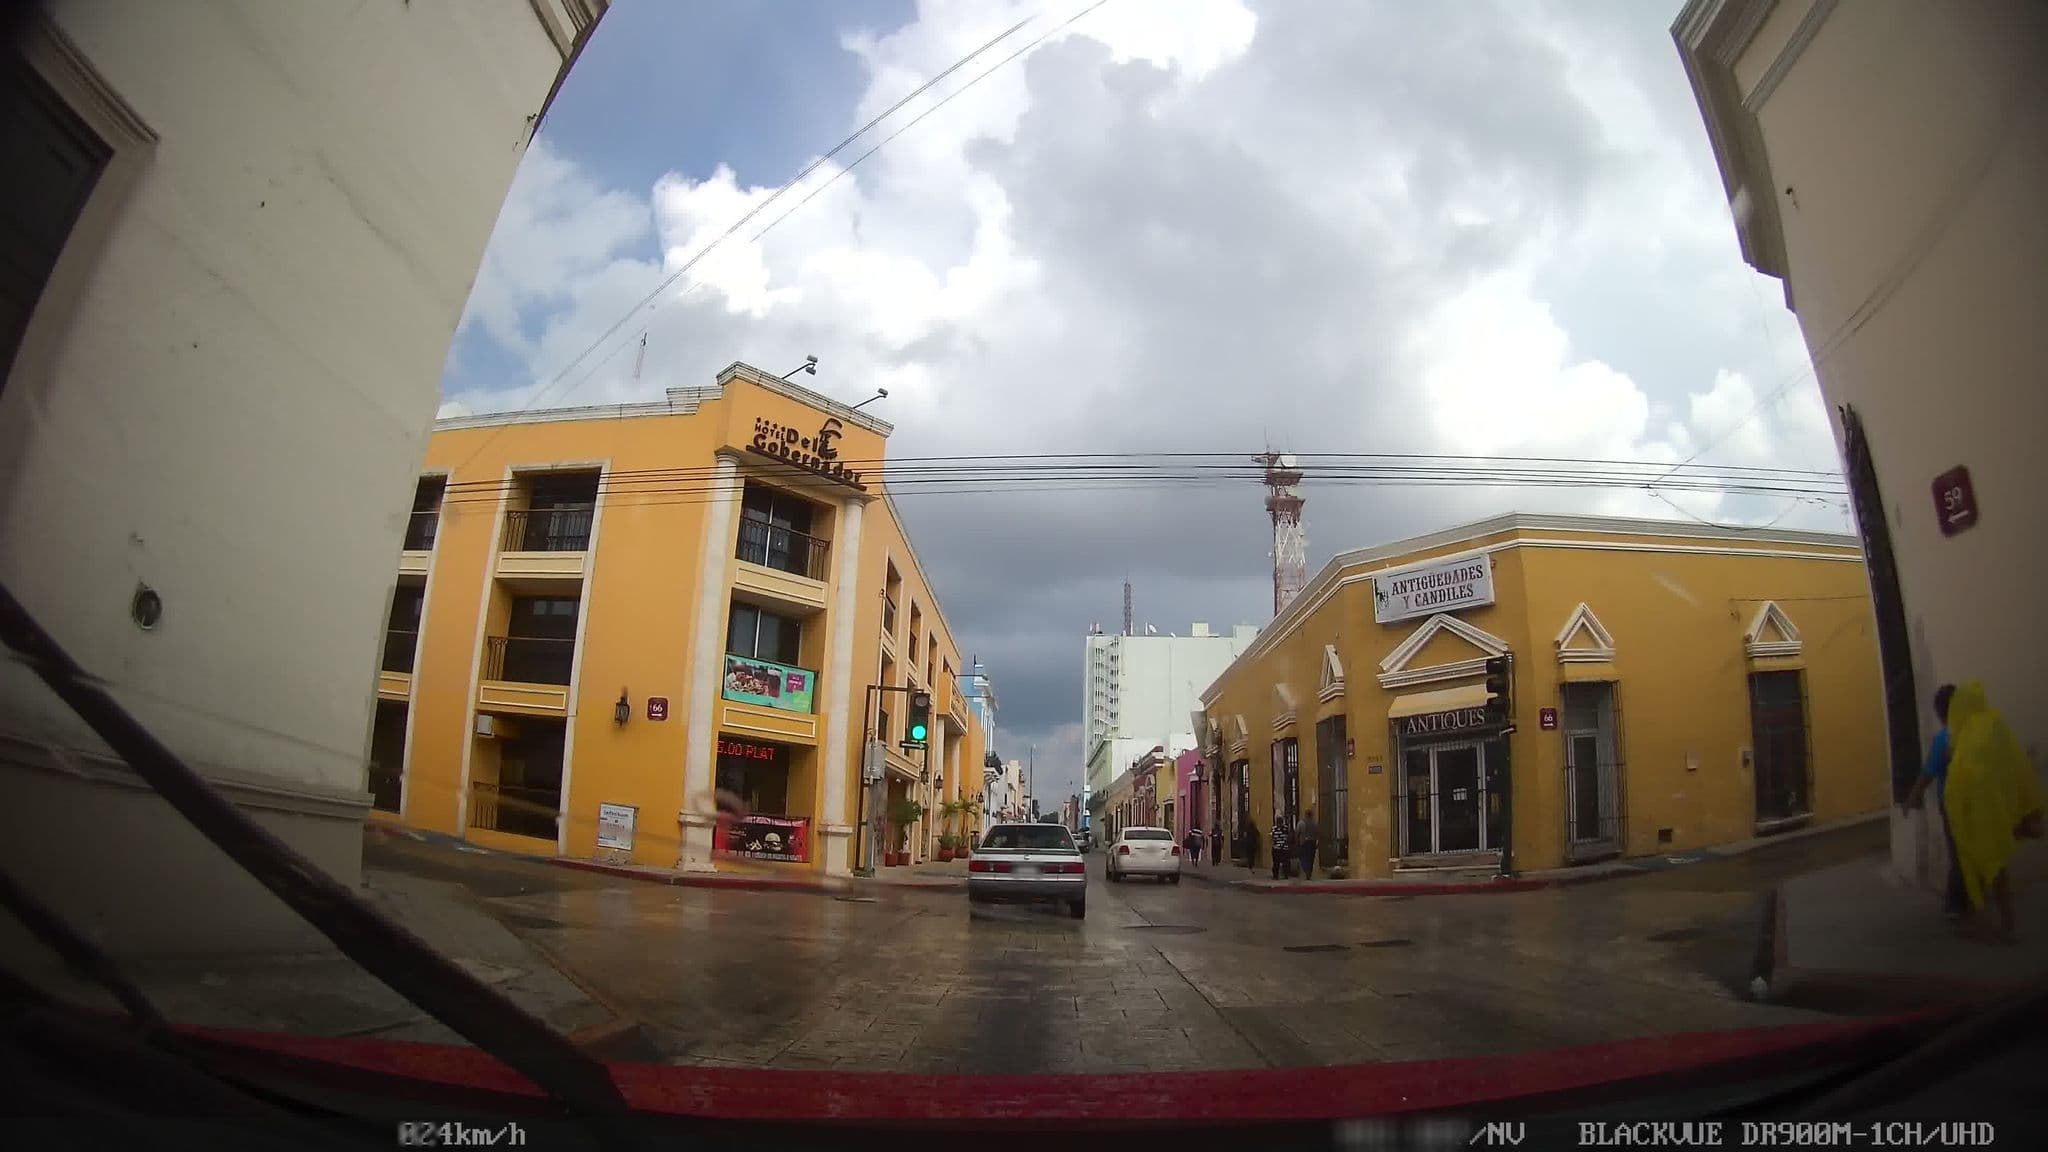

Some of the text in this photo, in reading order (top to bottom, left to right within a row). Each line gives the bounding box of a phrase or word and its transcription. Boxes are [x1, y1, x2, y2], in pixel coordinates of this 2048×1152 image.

[754, 423, 818, 453] HOTEL Del
[753, 433, 861, 482] Gobernador
[1944, 486, 1961, 510] 59
[1391, 564, 1484, 597] ANTIGÜEDADES
[1403, 582, 1474, 610] Y CANDILES
[652, 703, 663, 712] 66
[1544, 713, 1553, 722] 66
[1406, 708, 1486, 735] ANTIQUES
[746, 744, 776, 760] PLAT
